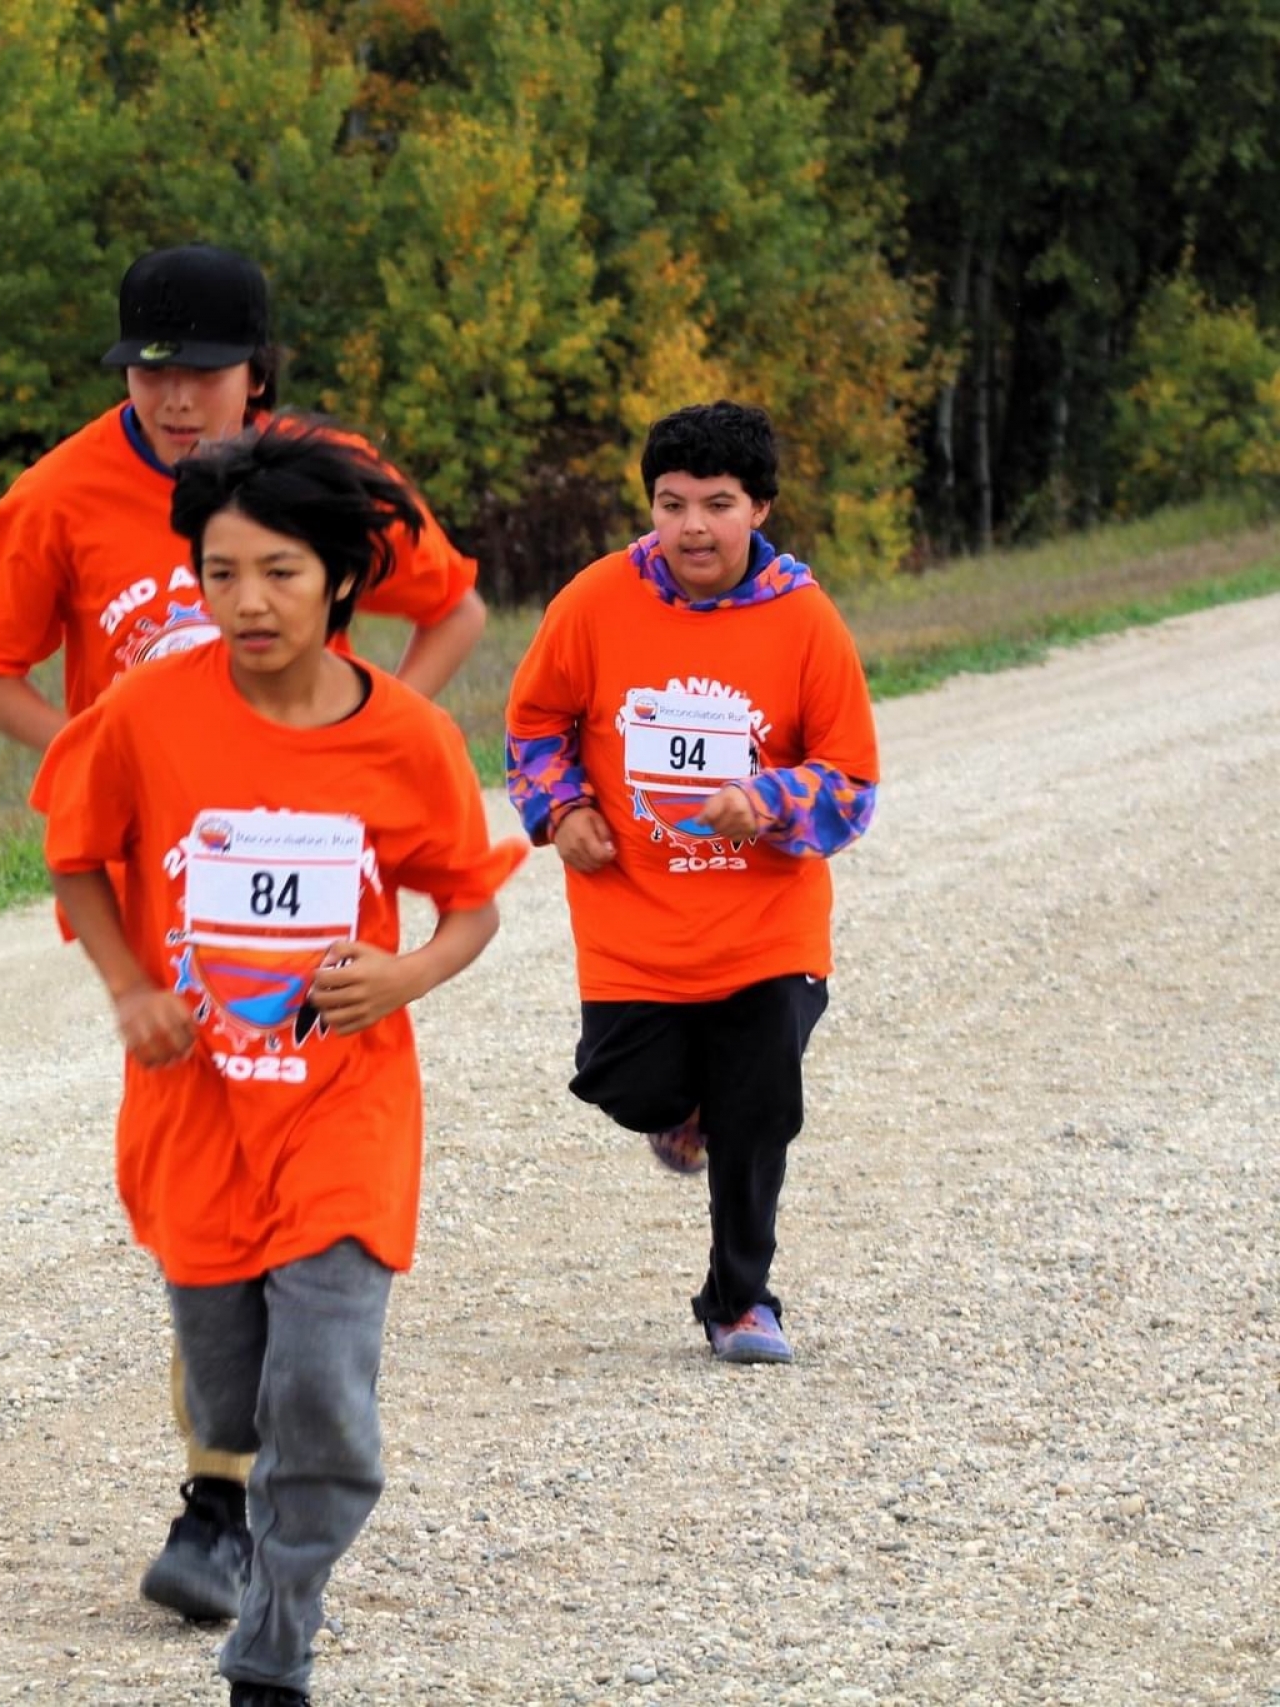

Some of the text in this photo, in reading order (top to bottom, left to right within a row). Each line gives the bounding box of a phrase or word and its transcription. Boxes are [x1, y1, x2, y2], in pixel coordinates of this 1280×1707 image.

[100, 577, 157, 635] 2ND
[658, 706, 725, 721] Reconciliation
[670, 735, 706, 771] 94
[669, 857, 747, 872] 2023
[250, 871, 301, 917] 84
